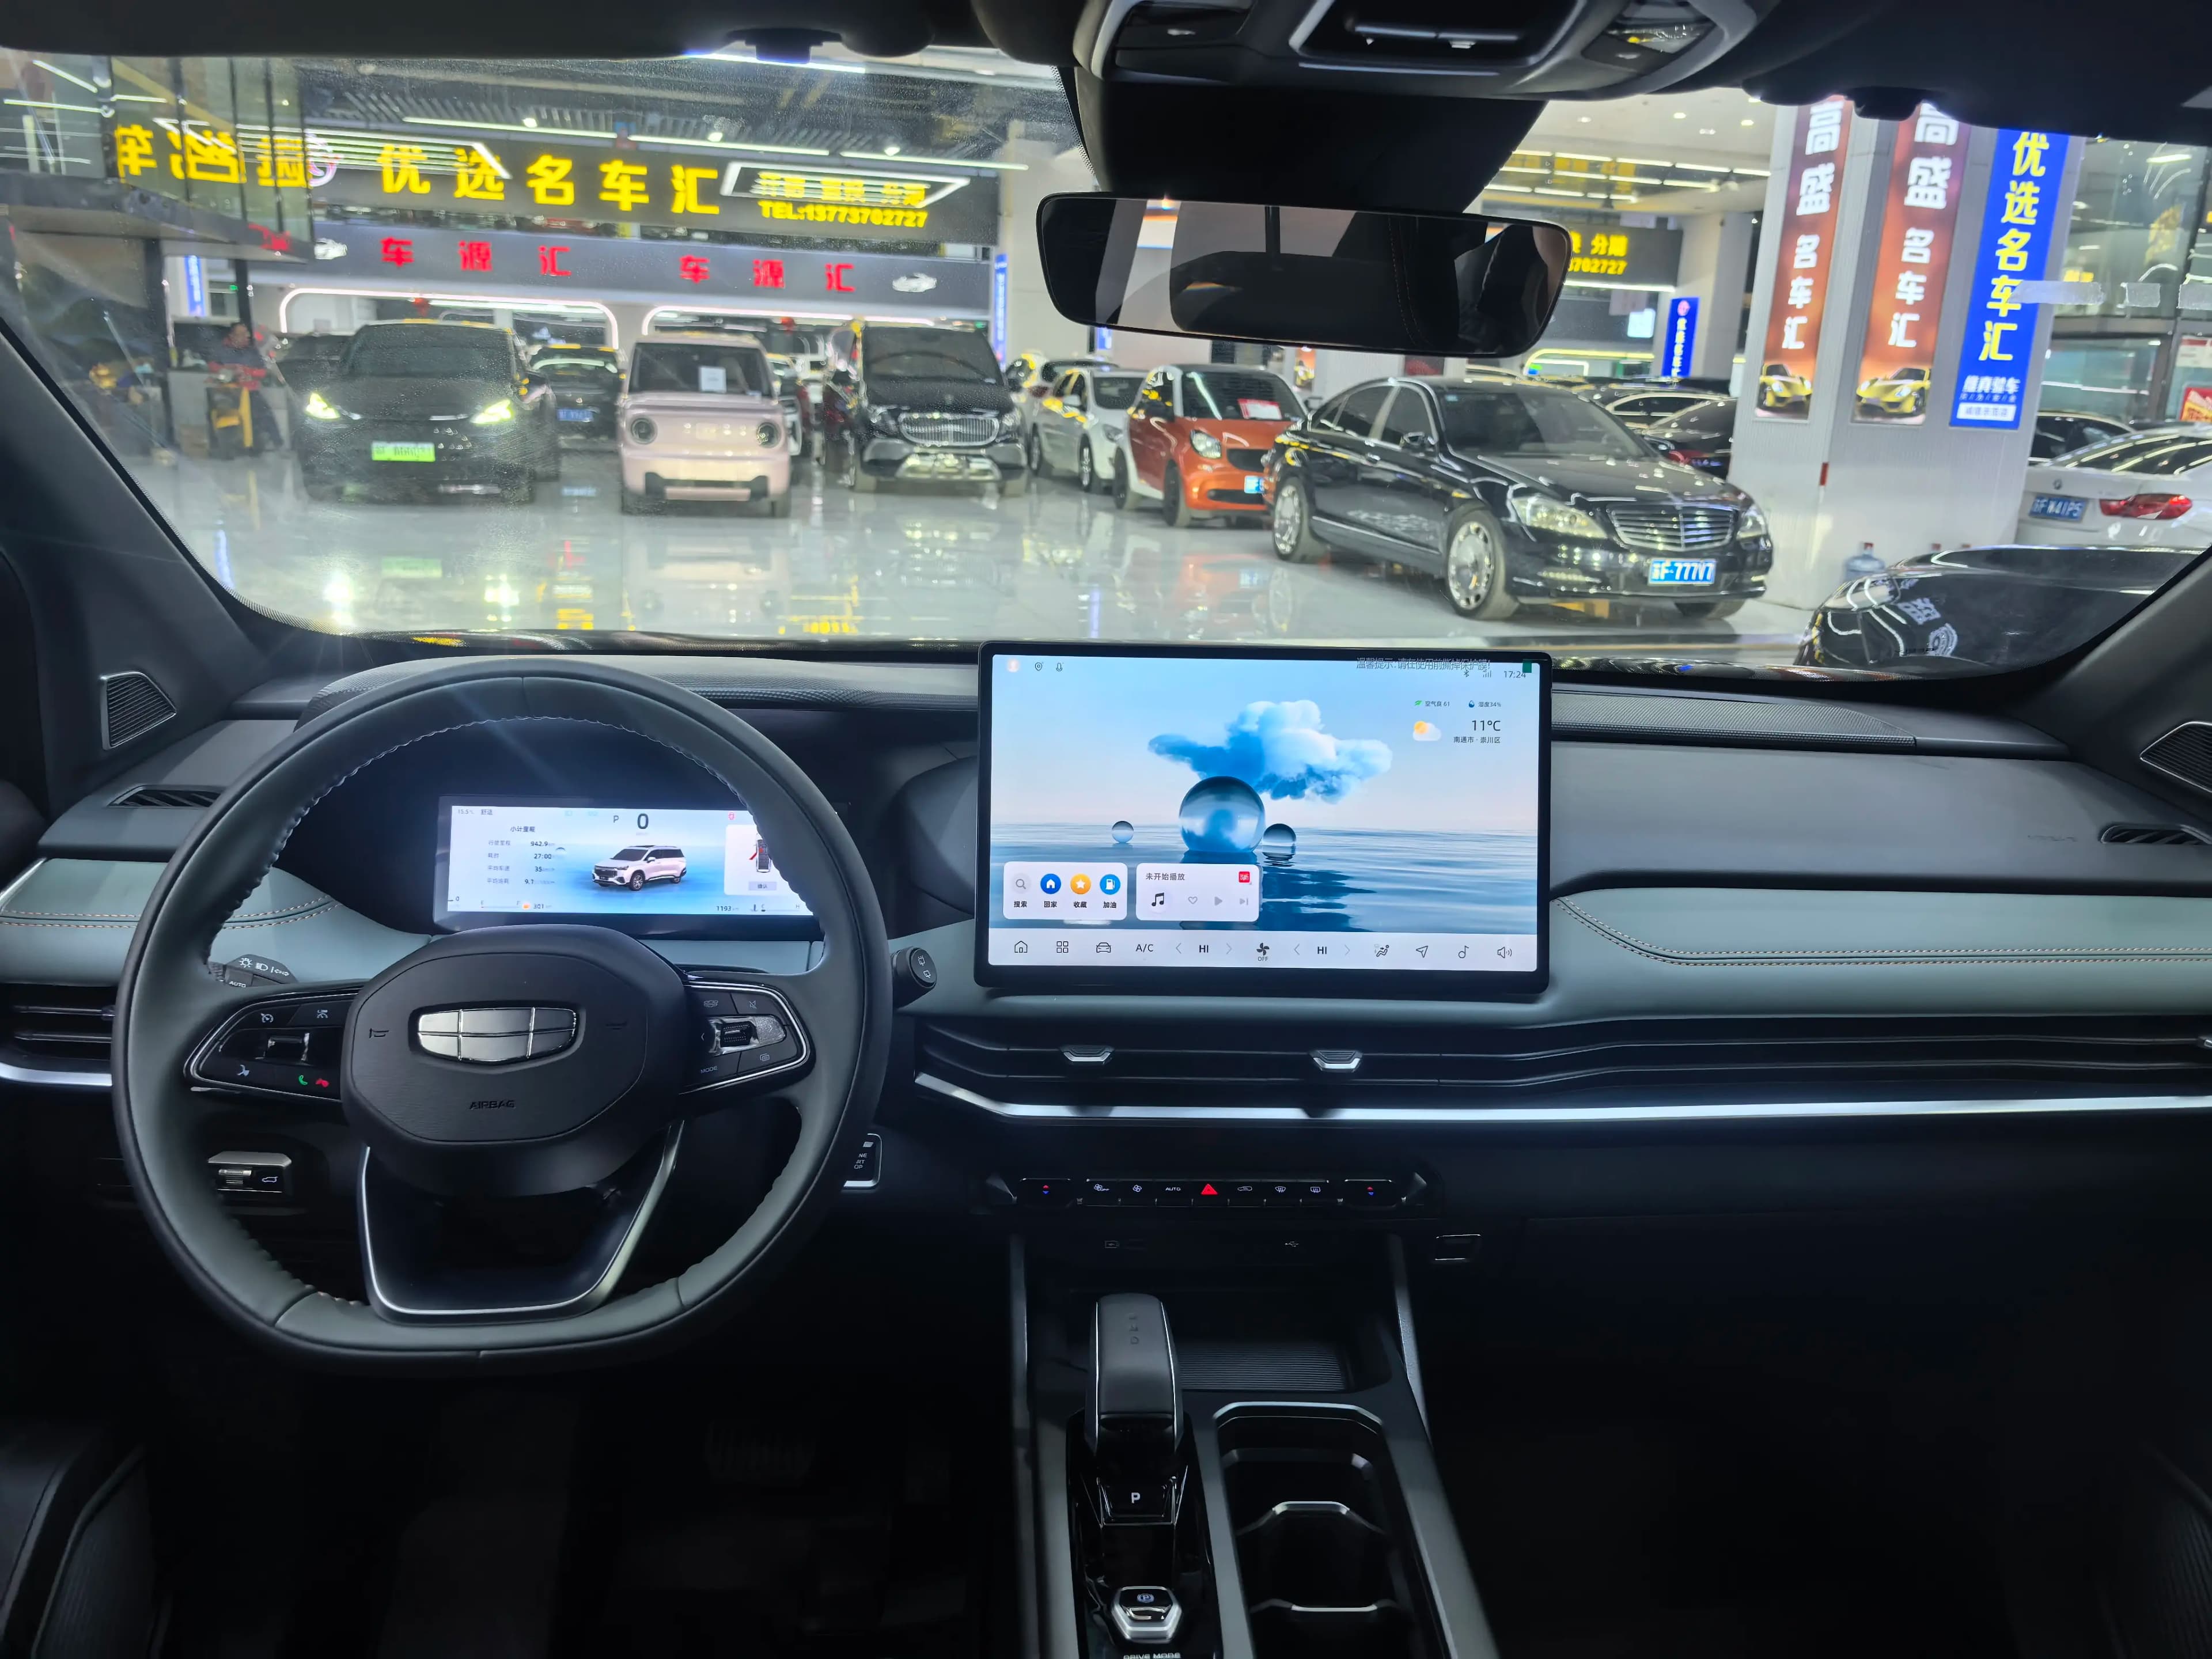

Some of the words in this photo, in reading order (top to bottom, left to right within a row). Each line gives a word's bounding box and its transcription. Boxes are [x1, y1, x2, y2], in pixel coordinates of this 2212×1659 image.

[376, 144, 720, 215] 优选名车汇
[1979, 132, 2048, 361] 优选名车汇
[380, 236, 573, 278] 车源汇
[679, 255, 856, 293] 车源汇
[1503, 671, 1527, 679] 17:24
[613, 815, 619, 823] P
[637, 813, 649, 830] 0
[1146, 872, 1185, 881] 未开始播放
[1135, 944, 1154, 953] A/C
[1199, 945, 1209, 953] HI
[1317, 946, 1327, 955] HI
[700, 1065, 718, 1074] MODE
[1131, 1492, 1141, 1504] P
